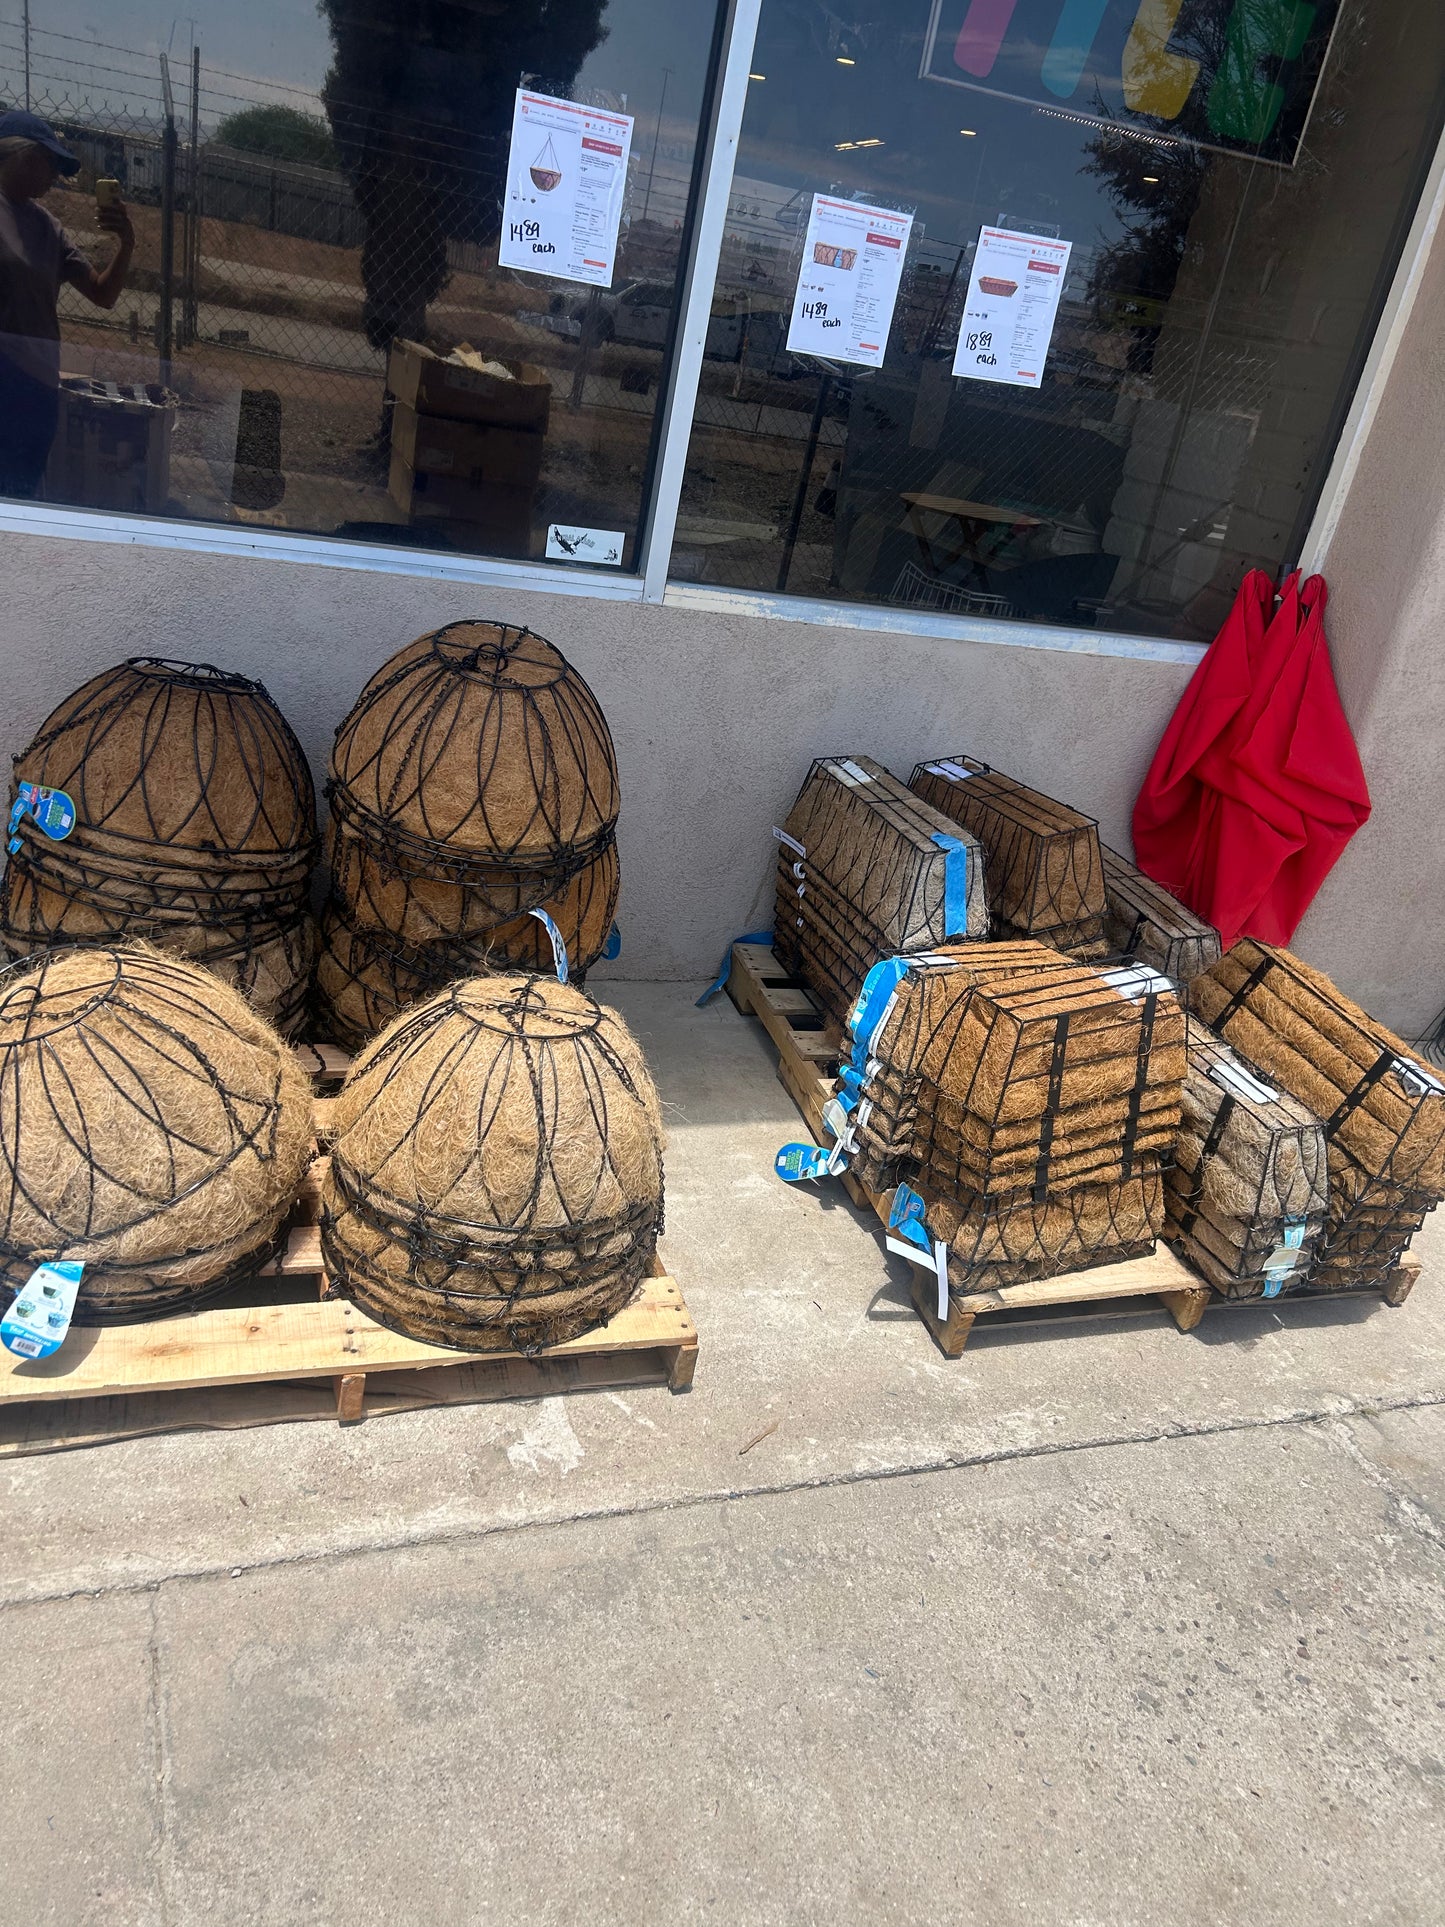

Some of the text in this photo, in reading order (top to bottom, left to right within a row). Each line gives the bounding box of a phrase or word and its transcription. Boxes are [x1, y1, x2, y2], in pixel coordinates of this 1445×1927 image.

[532, 242, 556, 254] each
[822, 317, 841, 328] each
[976, 353, 997, 366] each
